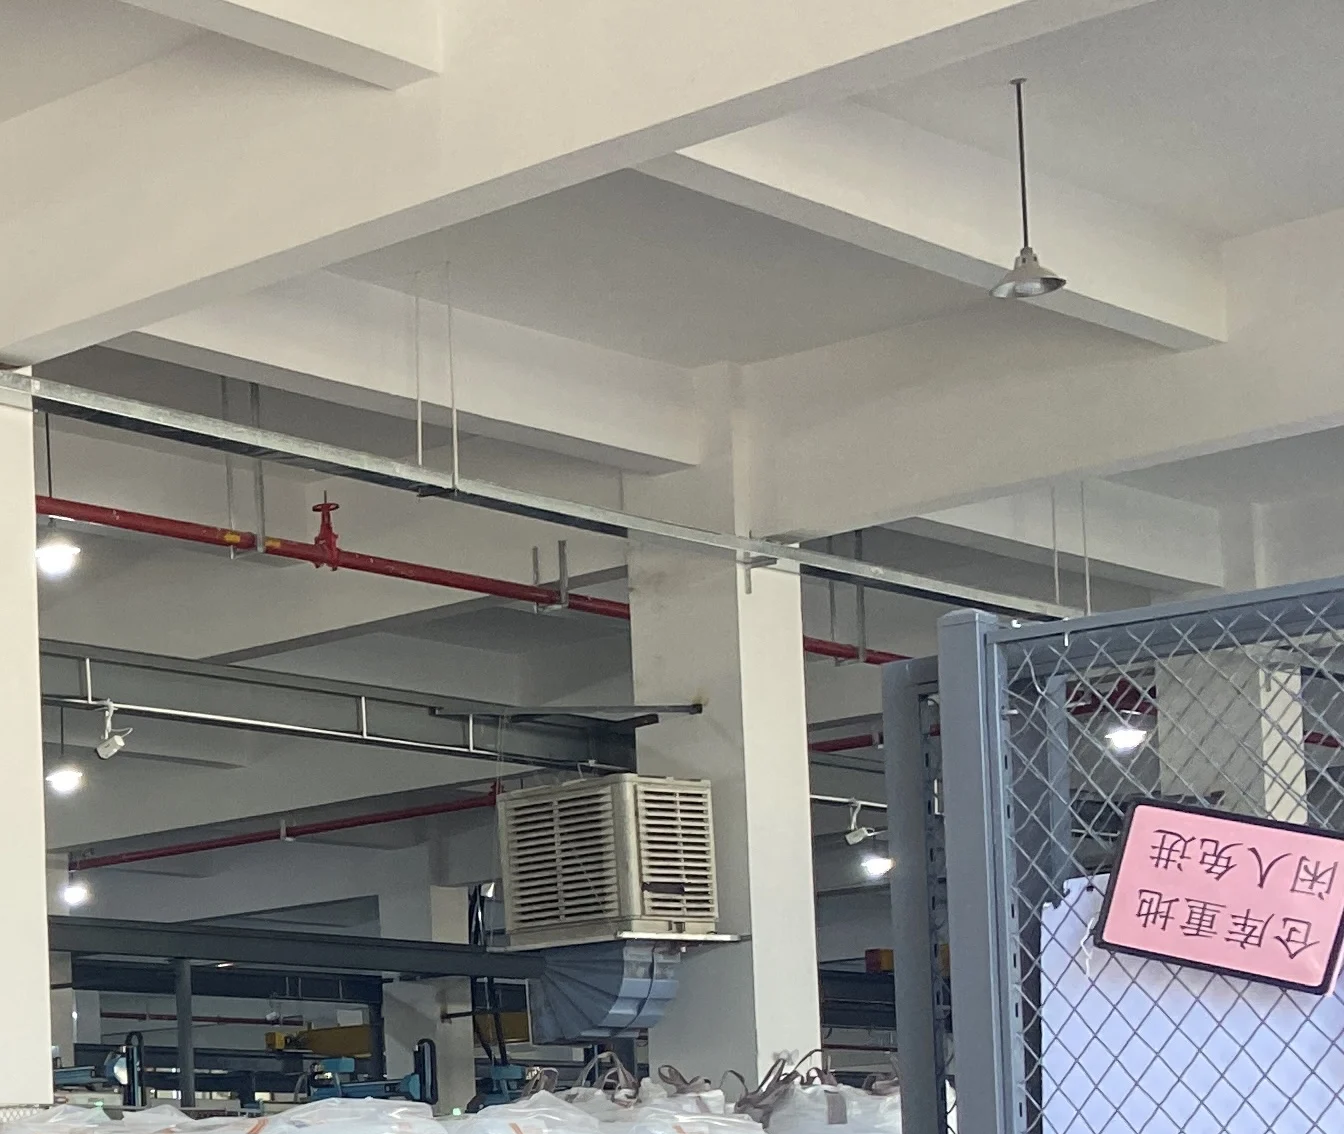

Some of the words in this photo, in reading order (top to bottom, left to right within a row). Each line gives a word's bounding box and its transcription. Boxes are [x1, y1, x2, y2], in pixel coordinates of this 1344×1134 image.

[1149, 829, 1338, 901] 闲人免进
[1136, 889, 1320, 959] 仓库重地
